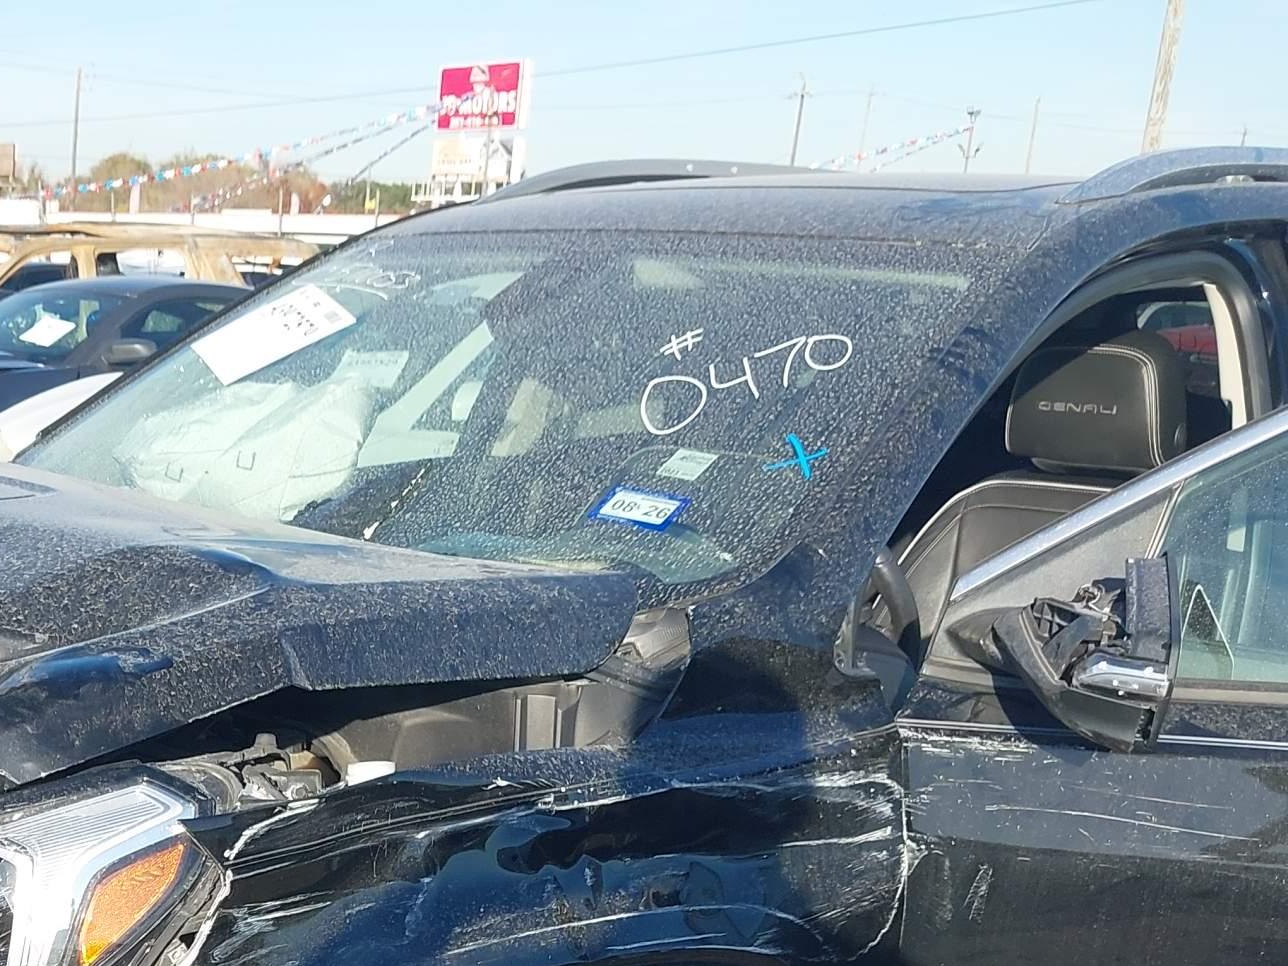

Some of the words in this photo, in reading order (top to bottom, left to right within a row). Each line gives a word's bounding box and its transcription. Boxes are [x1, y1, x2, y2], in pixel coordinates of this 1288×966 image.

[640, 334, 853, 436] 0470
[1038, 400, 1118, 416] DENALI
[642, 505, 671, 519] 26
